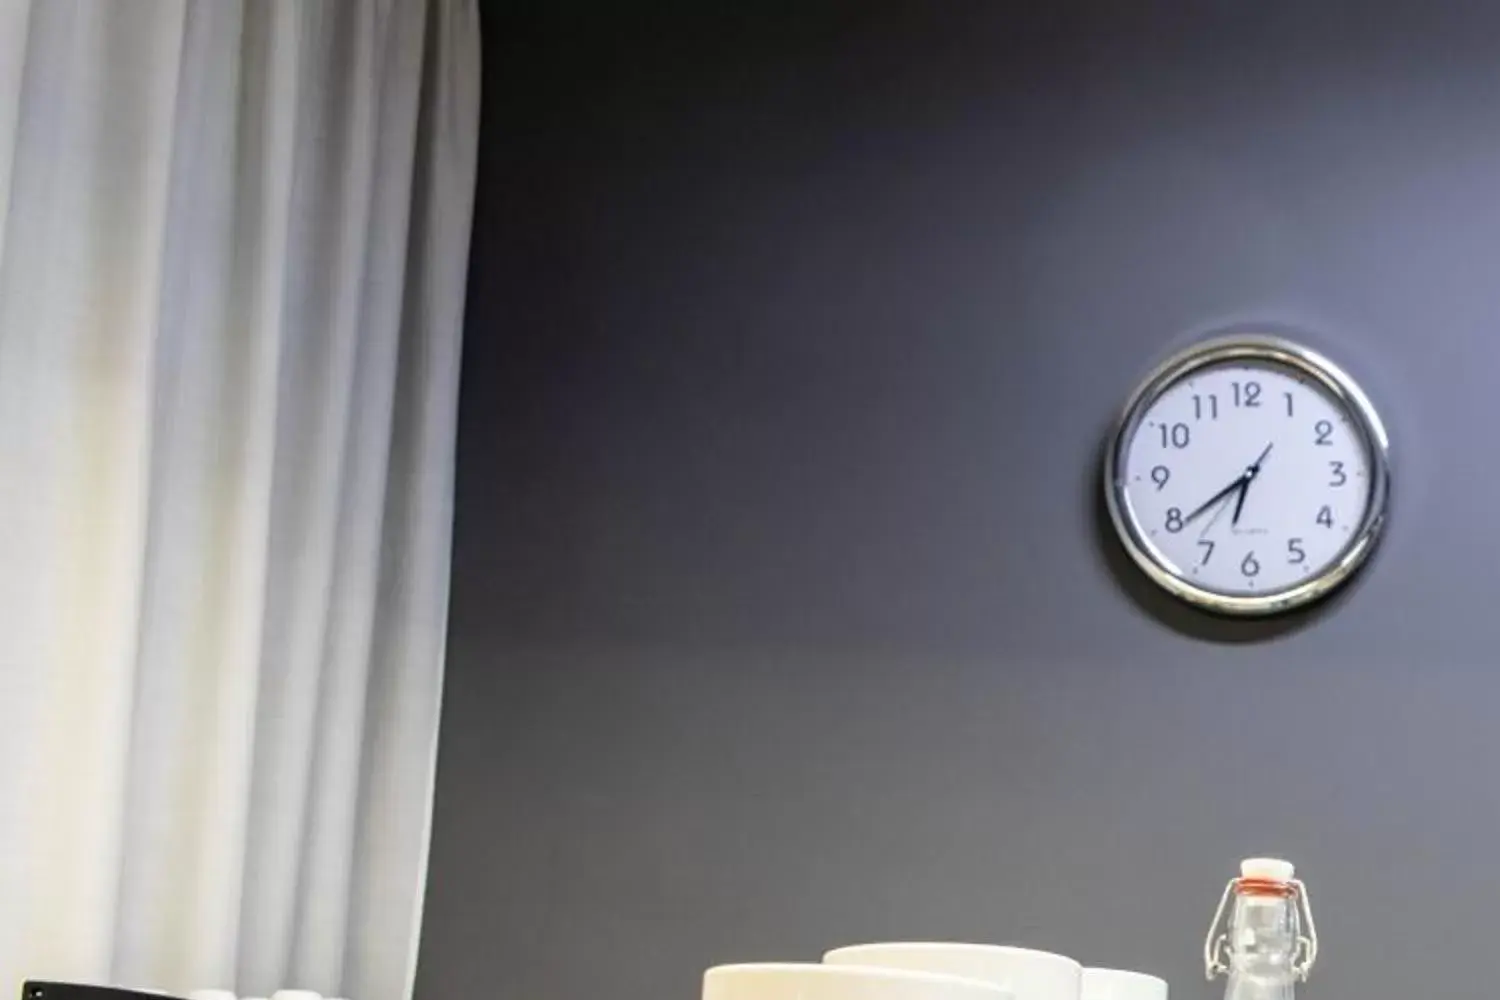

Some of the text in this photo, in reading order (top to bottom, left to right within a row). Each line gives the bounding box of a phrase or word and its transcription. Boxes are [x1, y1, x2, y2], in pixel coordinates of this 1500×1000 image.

[1192, 394, 1218, 420] 11
[1231, 381, 1262, 408] 12
[1284, 392, 1294, 417] 1
[1158, 422, 1191, 449] 10
[1314, 420, 1334, 446] 2
[1151, 465, 1171, 492] 9
[1328, 461, 1347, 487] 3
[1164, 507, 1184, 534] 8
[1315, 505, 1333, 529] 4
[1197, 540, 1215, 566] 7
[1241, 550, 1260, 578] 6
[1287, 538, 1306, 564] 5
